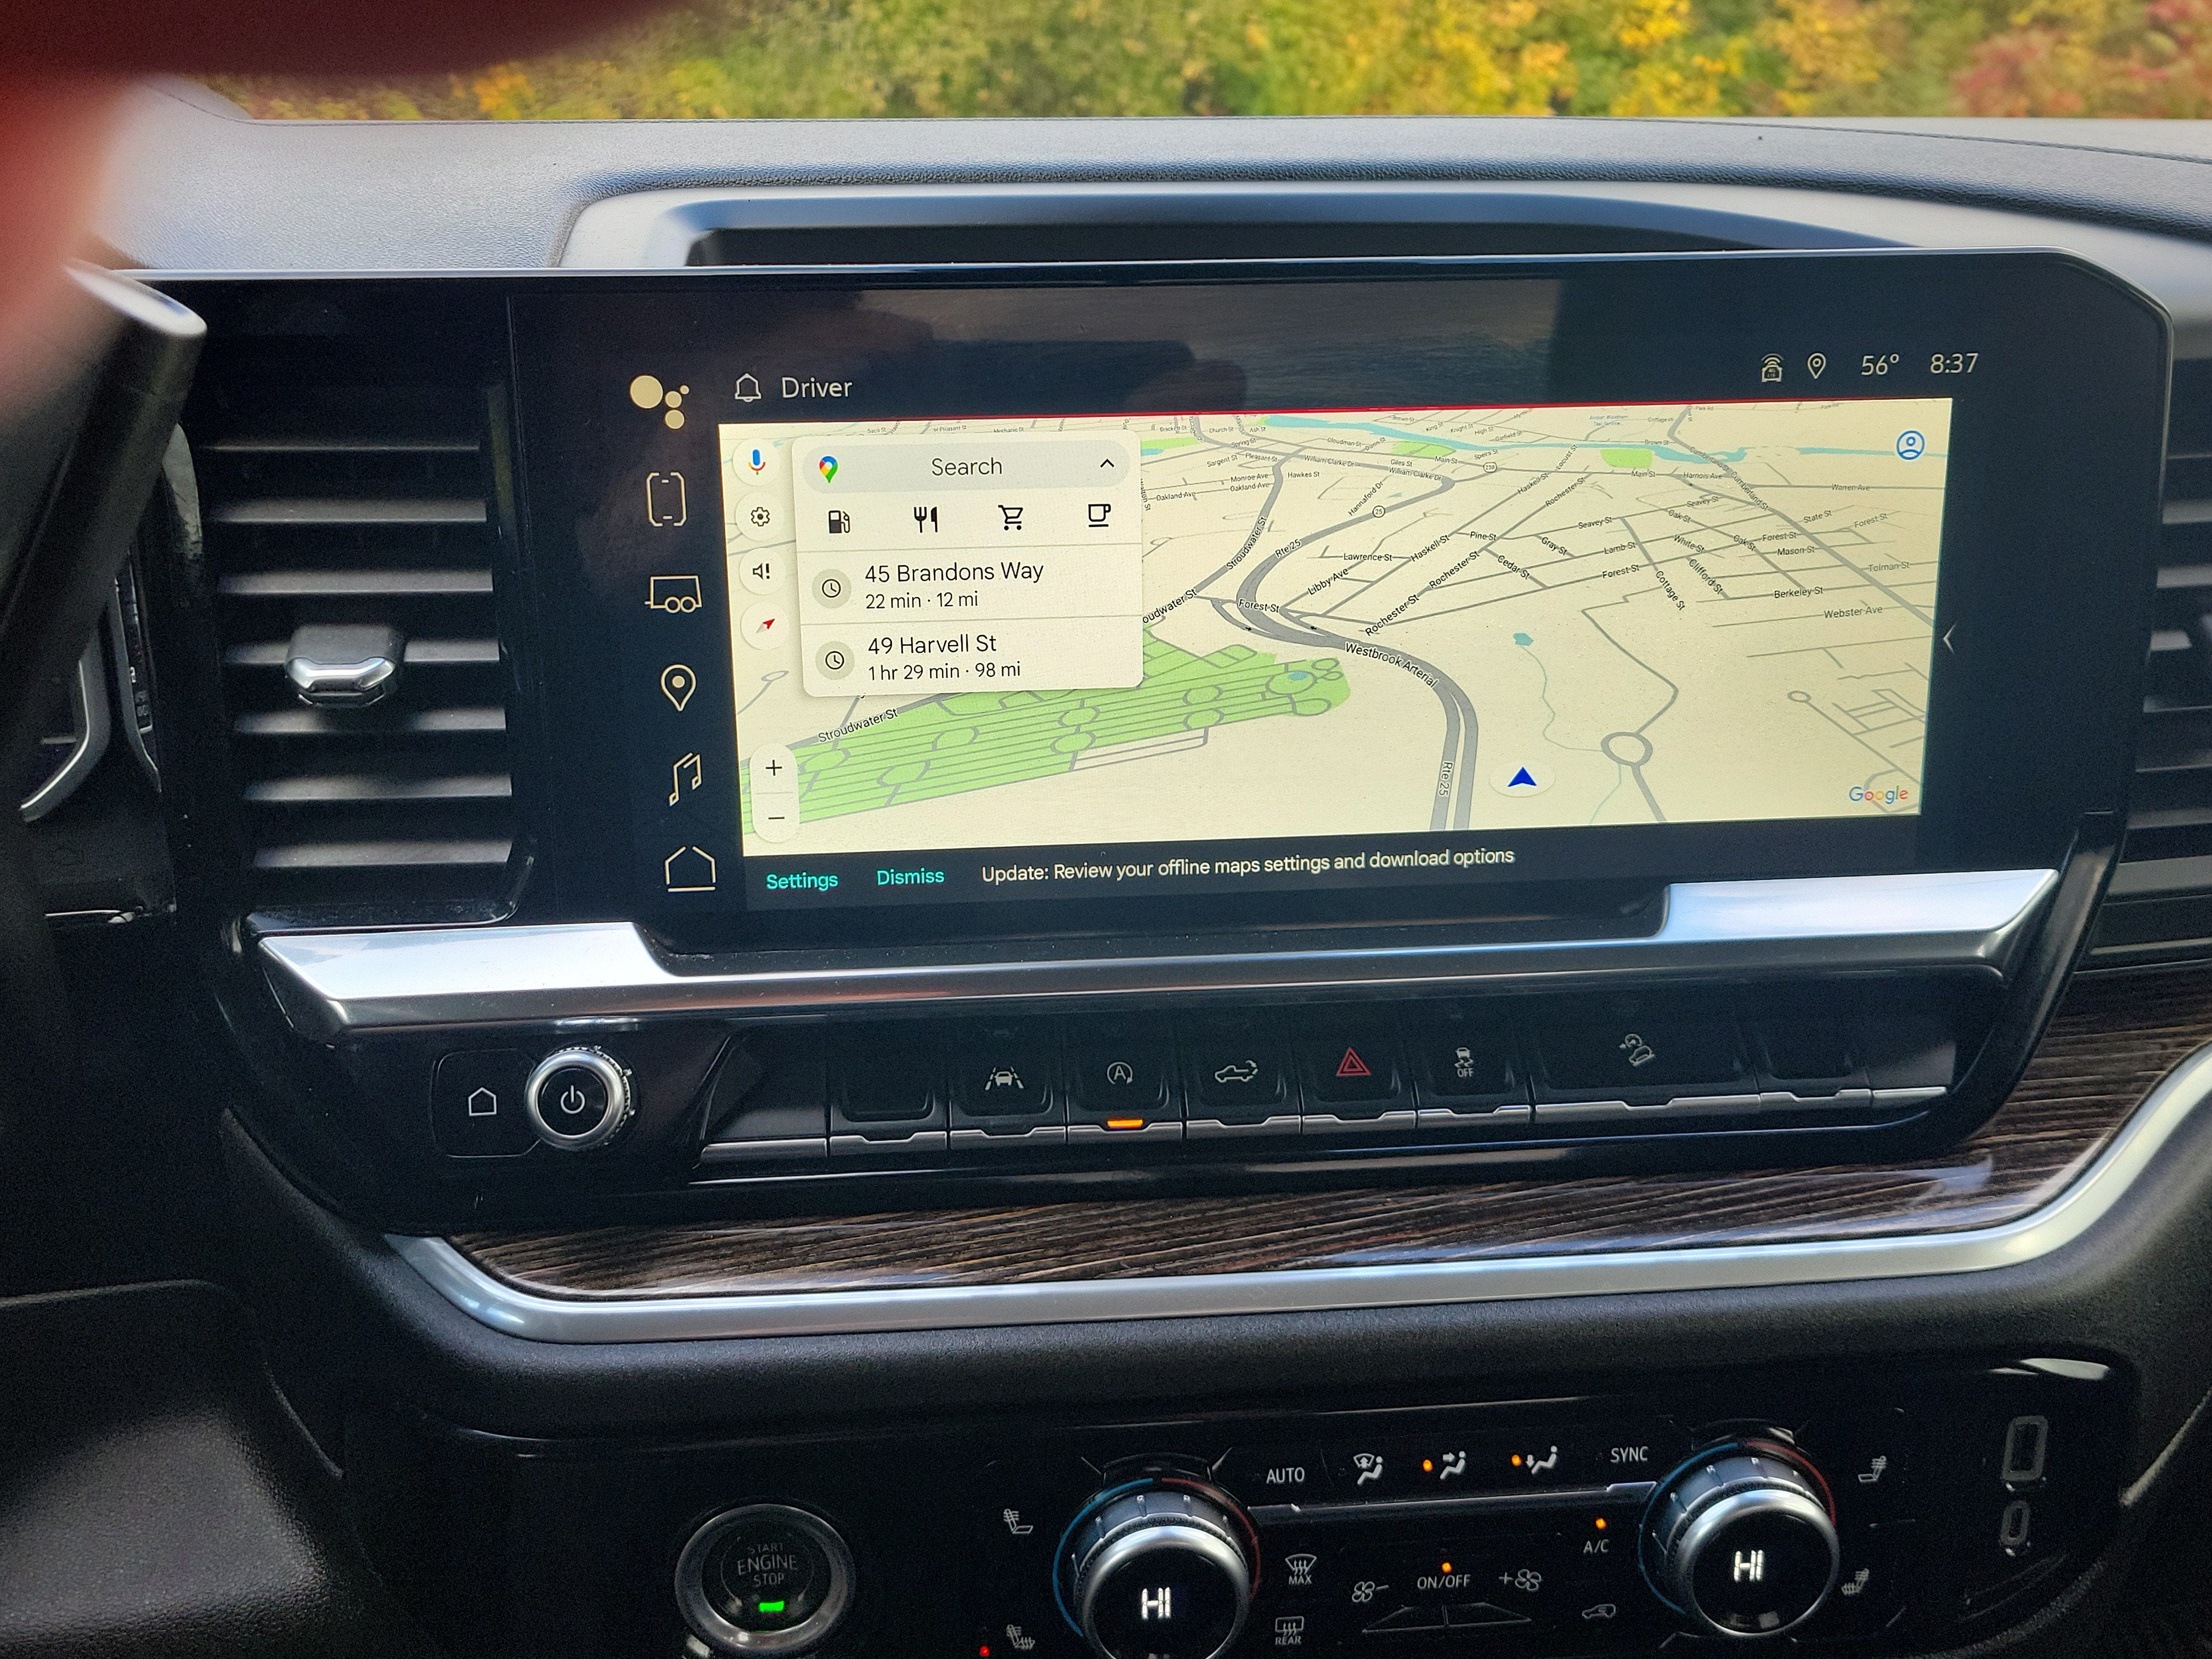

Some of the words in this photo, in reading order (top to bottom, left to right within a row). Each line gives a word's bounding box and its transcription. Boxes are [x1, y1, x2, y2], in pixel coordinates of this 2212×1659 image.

[1861, 353, 1899, 376] 56°
[1931, 353, 1978, 374] 8:37
[781, 377, 853, 398] Driver
[1231, 439, 1250, 448] Spring
[1327, 437, 1354, 446] Cloudman
[1207, 458, 1231, 467] Sargent
[1245, 453, 1271, 461] Pleasant
[1304, 455, 1327, 464] William
[1328, 458, 1346, 466] Clarke
[1556, 452, 1572, 471] Locust
[1571, 444, 1578, 453] St
[931, 458, 1003, 477] Search
[1389, 467, 1413, 476] William
[1413, 470, 1433, 479] Clarke
[1231, 474, 1255, 483] Monroe
[1517, 476, 1541, 494] Haskell
[1541, 472, 1549, 481] St
[1230, 483, 1256, 492] Oakland
[1545, 482, 1577, 507] Rochester
[1577, 477, 1586, 485] St
[1731, 471, 1762, 505] Cumberland
[1760, 502, 1768, 511] St
[1156, 492, 1182, 501] Oakland
[1348, 488, 1376, 516] Hannaford
[1375, 481, 1384, 490] Dr
[1686, 498, 1711, 507] Seavey
[1578, 518, 1602, 529] Seavey
[1668, 510, 1682, 520] Oak
[1682, 515, 1691, 523] St
[1803, 512, 1823, 523] State
[1854, 516, 1877, 528] Forest
[1227, 527, 1262, 570] Stroudwater
[1257, 517, 1267, 526] St
[1470, 532, 1486, 540] Pine
[1487, 533, 1497, 541] St
[1673, 534, 1695, 550] White
[1695, 545, 1705, 554] St
[1734, 535, 1747, 546] Oak
[1747, 543, 1756, 551] St
[1762, 533, 1786, 542] Forest
[1275, 545, 1290, 558] Rte
[1289, 539, 1301, 550] 25
[1410, 540, 1440, 562] Haskell
[1439, 534, 1450, 545] St
[1541, 537, 1559, 550] Gray
[1559, 546, 1567, 555] St
[1604, 544, 1626, 554] Lamb
[1627, 541, 1635, 550] St
[1777, 547, 1804, 556] Mason
[1343, 553, 1383, 561] Lawrence
[1384, 553, 1393, 562] St
[865, 565, 890, 583] 45
[898, 562, 995, 582] Brandons
[1001, 562, 1044, 584] Way
[1429, 558, 1470, 589] Rochester
[1469, 550, 1480, 560] St
[1498, 555, 1519, 573] Cedar
[1519, 569, 1530, 580] St
[1602, 567, 1629, 578] Forest
[1631, 565, 1639, 573] St
[1868, 563, 1897, 572] Tolman
[1308, 577, 1331, 596] Libby
[1333, 568, 1349, 582] Ave
[1689, 558, 1716, 586] Clifford
[1713, 584, 1723, 595] St
[1186, 588, 1197, 599] St
[1656, 571, 1678, 602] Cottage
[1676, 600, 1685, 611] St
[1774, 588, 1812, 599] Berkeley
[1814, 586, 1823, 595] St
[866, 594, 885, 609] 22
[891, 592, 921, 608] min
[936, 592, 953, 607] 12
[959, 590, 978, 607] mi
[1239, 599, 1267, 612] Forest
[1268, 603, 1279, 613] St
[1365, 602, 1408, 636] Rochester
[1408, 594, 1419, 605] St
[1824, 609, 1863, 619] Webster
[1865, 606, 1883, 615] Ave
[868, 637, 893, 654] 49
[900, 634, 969, 654] Harvell
[977, 634, 997, 652] St
[869, 666, 874, 681] 1
[881, 665, 898, 680] hr
[904, 664, 923, 680] 29
[929, 663, 960, 679] min
[975, 662, 996, 678] 98
[1002, 661, 1020, 676] mi
[1345, 642, 1402, 668] Westbrook
[1402, 659, 1438, 689] Arterial
[818, 713, 884, 743] Stroudwater
[884, 708, 898, 720] St
[1441, 762, 1453, 780] Rte
[1438, 782, 1450, 796] 25
[1849, 785, 1908, 804] Google
[981, 865, 1049, 885] Update:
[1053, 861, 1113, 881] Review
[1116, 862, 1154, 882] your
[1158, 858, 1210, 876] offline
[1215, 859, 1260, 877] maps
[1264, 854, 1330, 874] settings
[1333, 852, 1365, 870] and
[1369, 849, 1450, 868] download
[1453, 848, 1516, 868] options
[766, 873, 839, 891] Settings
[877, 868, 945, 886] Dismiss
[1457, 1068, 1474, 1077] OFF
[1610, 1447, 1649, 1463] SYNC
[1266, 1468, 1305, 1484] AUTO
[748, 1543, 783, 1554] START
[1584, 1539, 1609, 1554] A/C
[737, 1554, 798, 1576] ENGINE
[1733, 1549, 1764, 1582] HI
[753, 1572, 785, 1587] STOP
[1288, 1575, 1312, 1585] MAX
[1417, 1574, 1472, 1589] ON/OFF
[1141, 1587, 1171, 1620] HI
[1275, 1635, 1302, 1646] REAR
